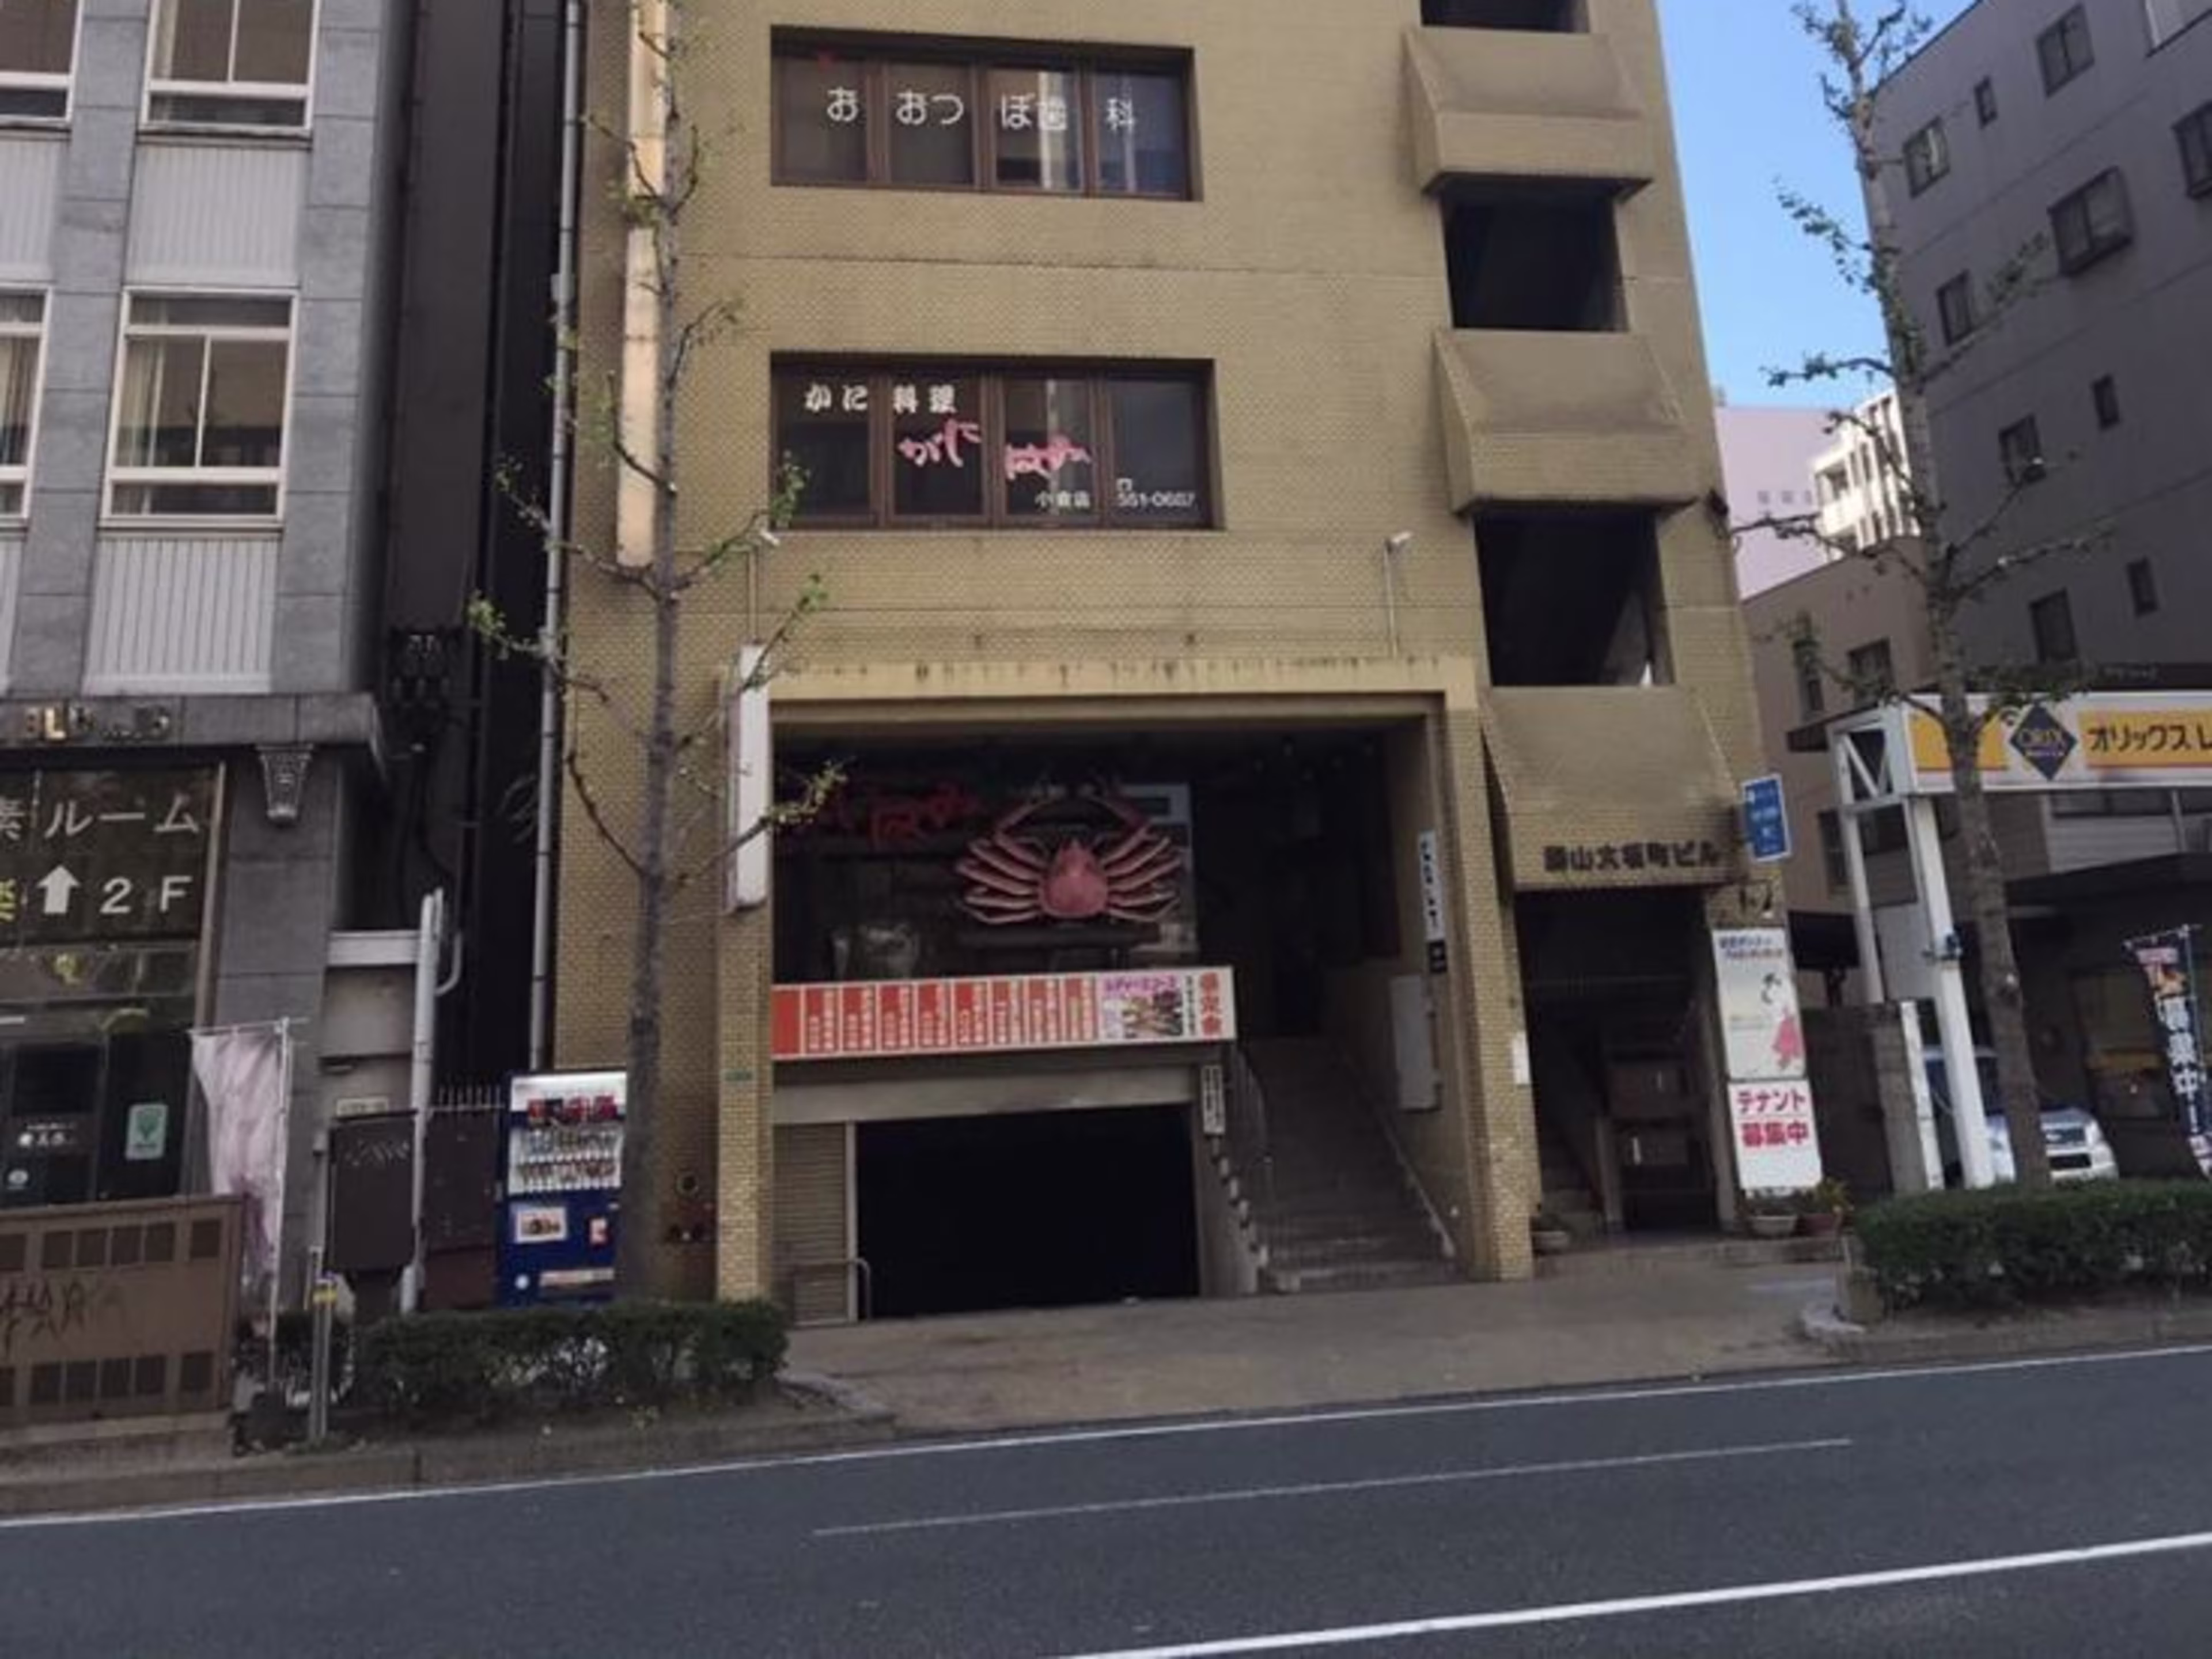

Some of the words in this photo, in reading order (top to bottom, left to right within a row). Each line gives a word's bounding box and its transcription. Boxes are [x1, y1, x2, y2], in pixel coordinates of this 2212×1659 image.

[1737, 1088, 1806, 1114] テナント
[1742, 1120, 1809, 1147] 募集中
